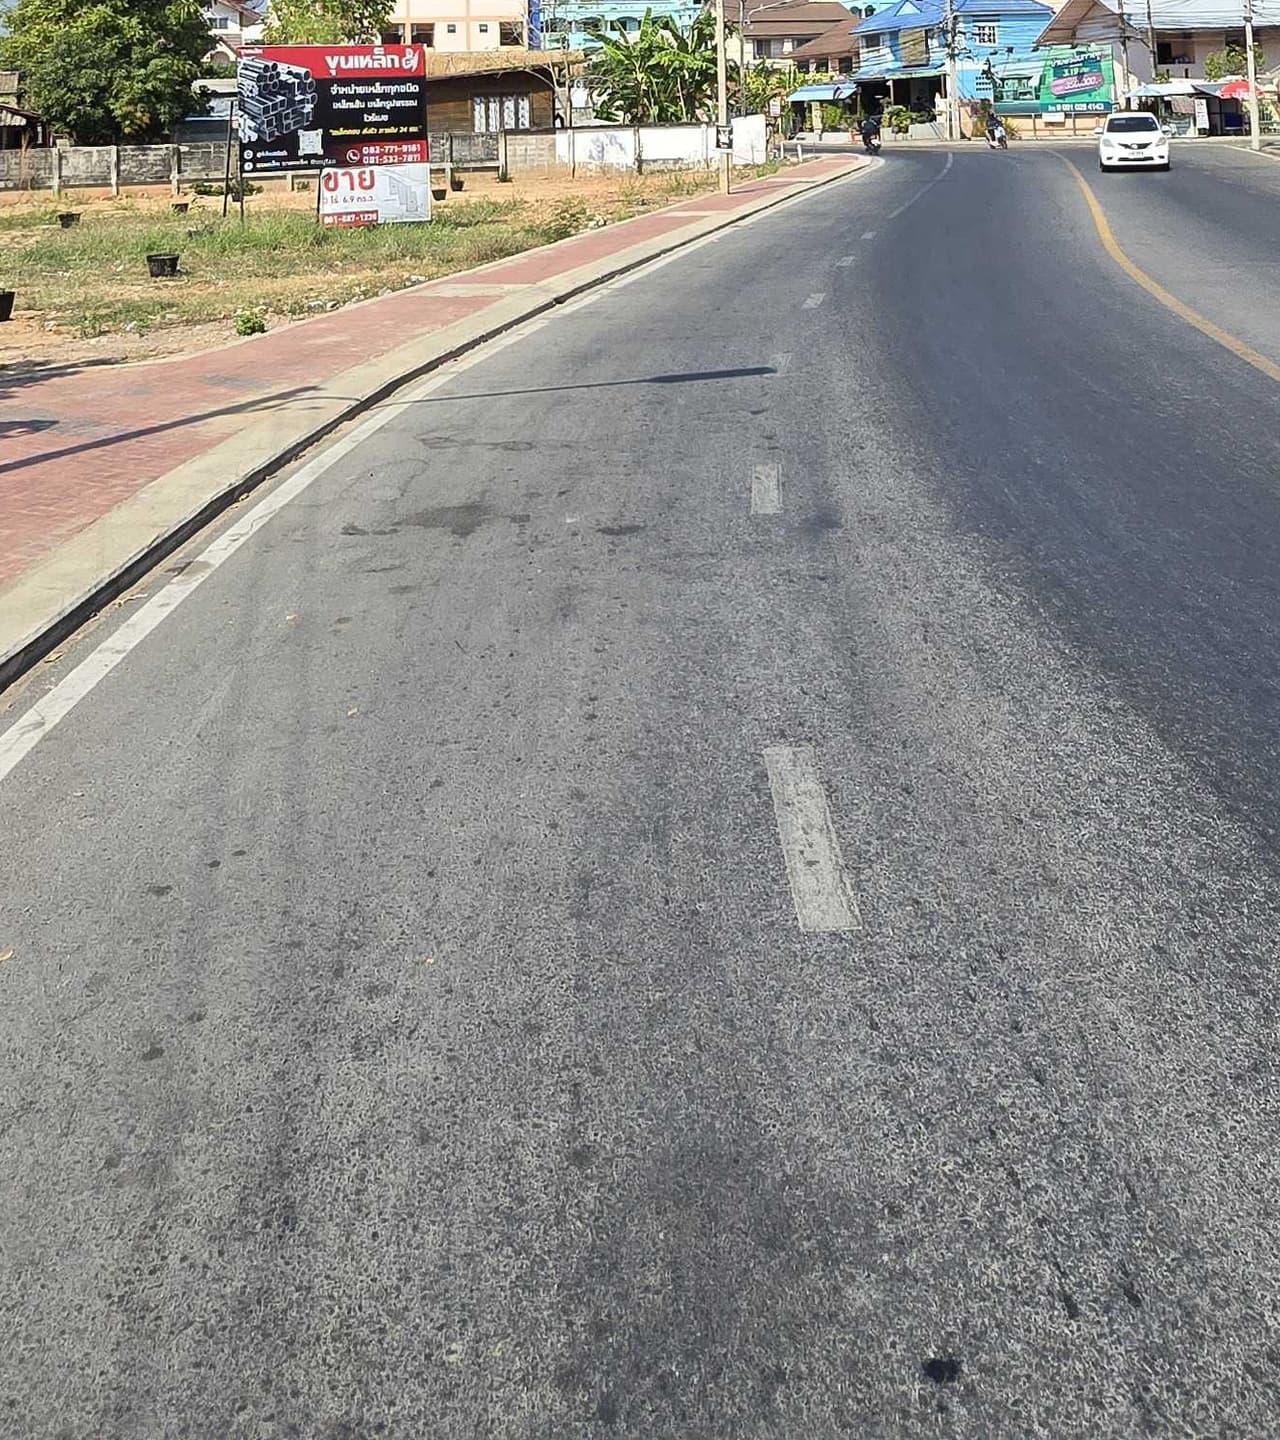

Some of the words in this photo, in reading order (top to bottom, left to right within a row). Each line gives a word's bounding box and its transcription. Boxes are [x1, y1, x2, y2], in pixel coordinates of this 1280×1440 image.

[330, 82, 419, 95] จำหน่ายเหล็กทุกชนิด
[322, 169, 375, 192] ขาย
